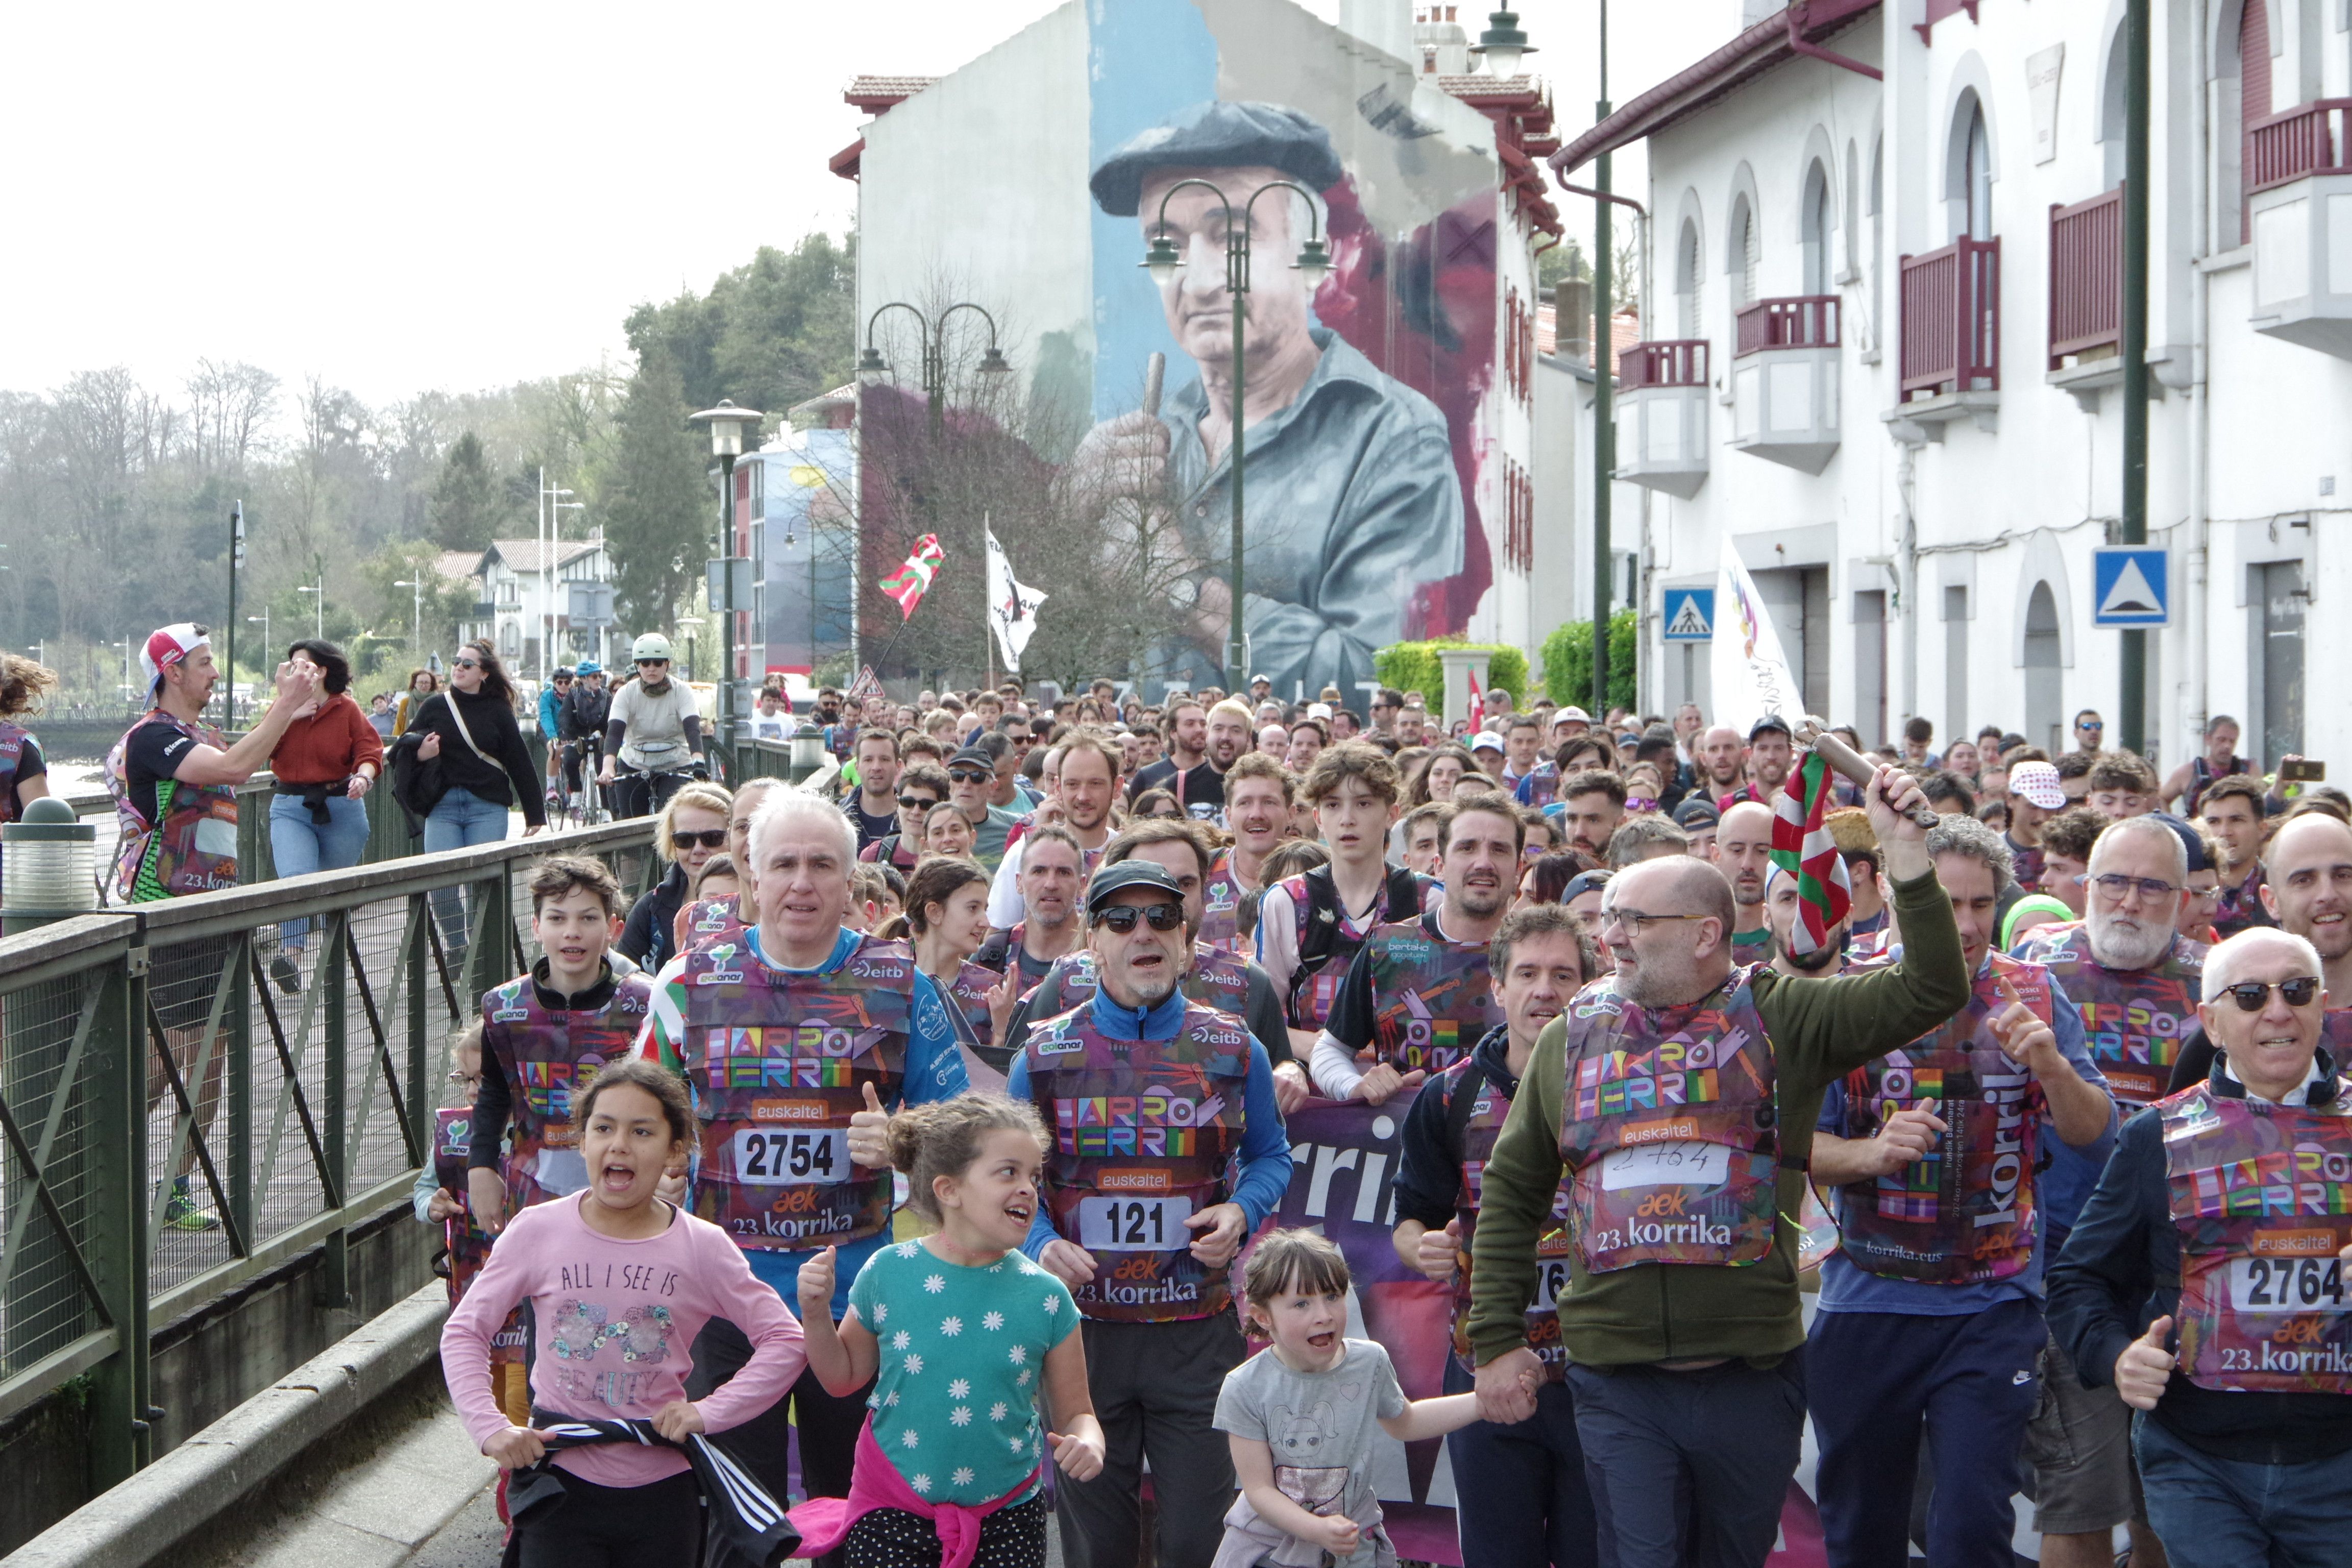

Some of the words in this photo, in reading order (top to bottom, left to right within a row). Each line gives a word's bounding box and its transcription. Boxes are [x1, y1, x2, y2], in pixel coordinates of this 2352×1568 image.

[870, 967, 903, 979] eitb
[1215, 974, 1241, 987] eitb
[1209, 1032, 1241, 1045] eitb
[757, 1104, 823, 1119] euskaltel
[1625, 1122, 1693, 1143] euskaltel
[1974, 1051, 2030, 1228] korrik
[745, 1134, 833, 1176] 2754
[1102, 1173, 1166, 1188] euskaltel
[1107, 1202, 1163, 1243] 121
[1866, 1240, 1943, 1263] korrika.eus
[2259, 1235, 2331, 1251] euskaltel
[562, 1263, 593, 1290] ALL
[606, 1264, 611, 1288] I
[623, 1265, 654, 1291] SEE
[660, 1271, 678, 1296] IS
[2247, 1258, 2344, 1306] 2764
[556, 1364, 663, 1408] BEAUTY
